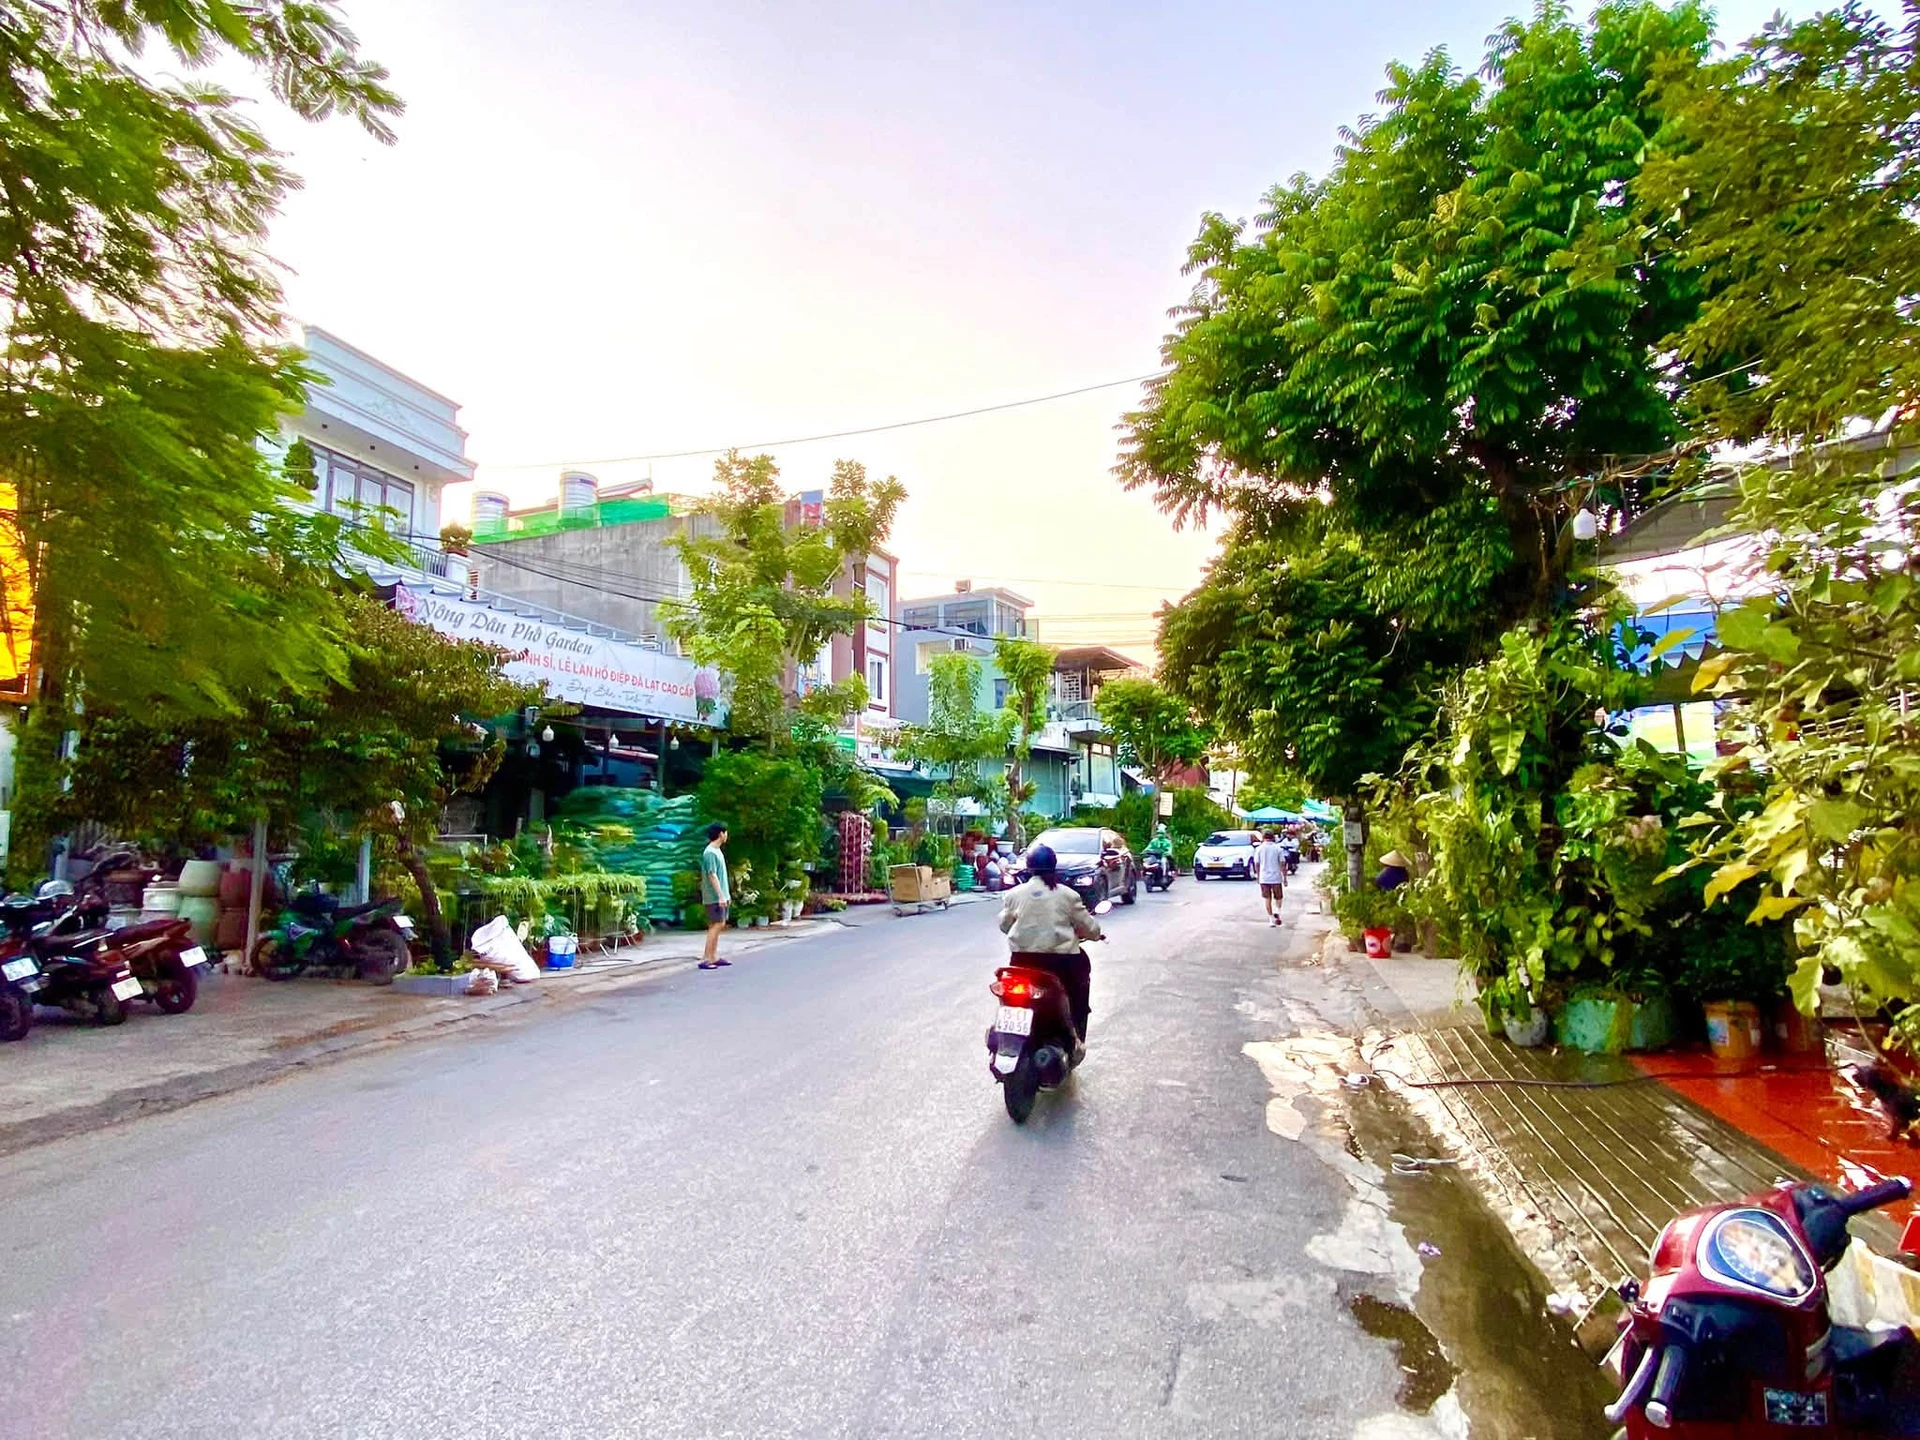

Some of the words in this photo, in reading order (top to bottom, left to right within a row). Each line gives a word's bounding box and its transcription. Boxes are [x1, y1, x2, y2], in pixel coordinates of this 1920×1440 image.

[419, 599, 465, 628] Nông
[470, 612, 507, 634] Dân
[545, 631, 593, 655] Garden
[573, 662, 593, 679] LAN
[661, 681, 679, 696] CAO
